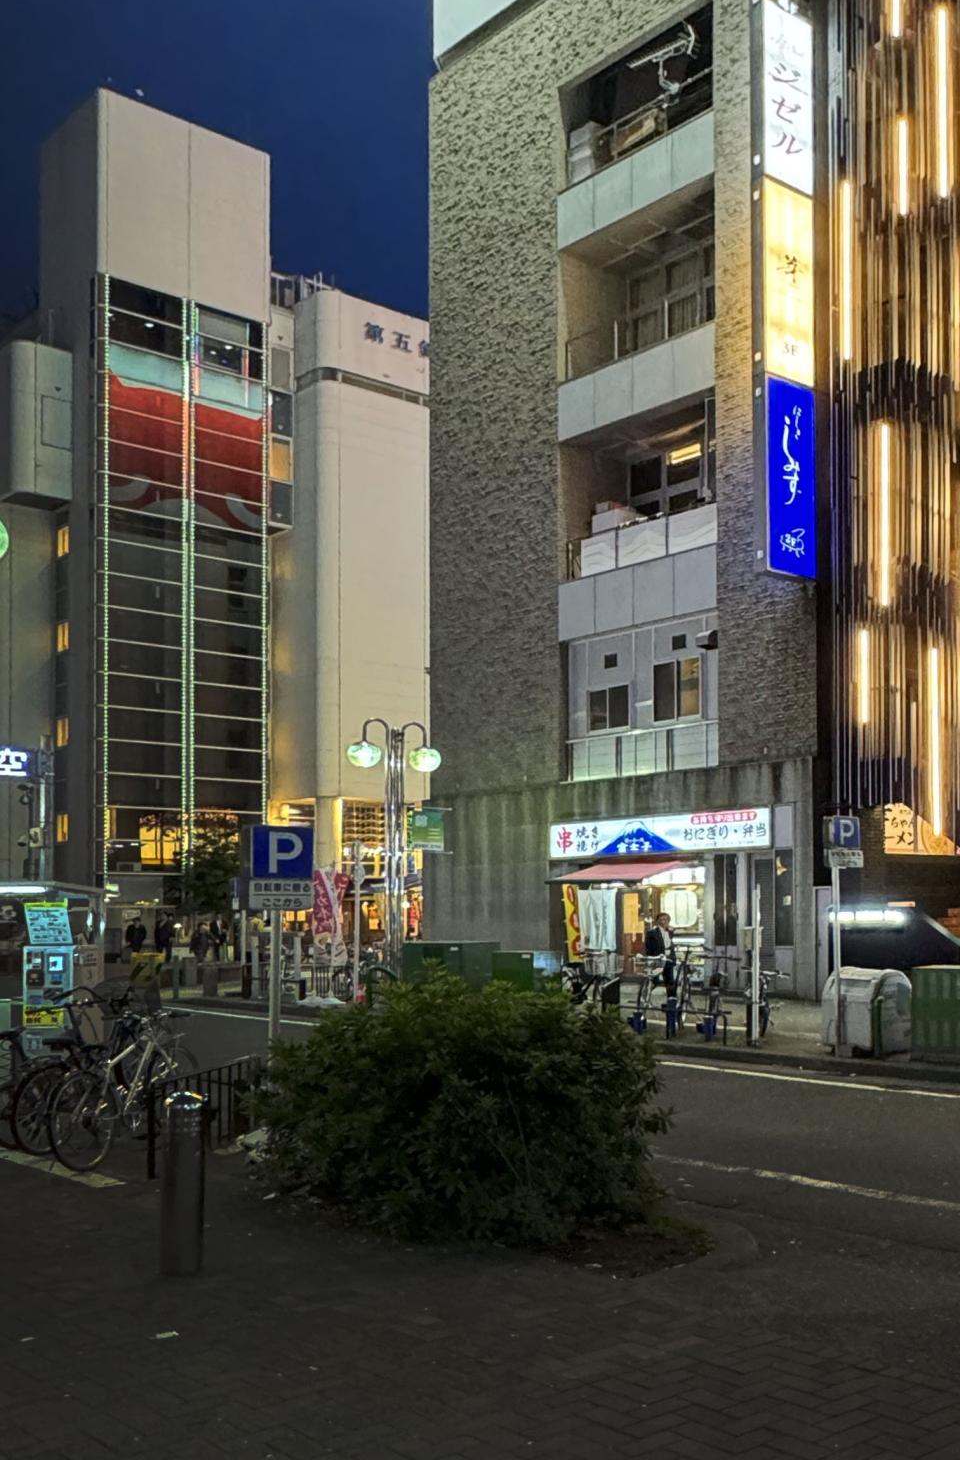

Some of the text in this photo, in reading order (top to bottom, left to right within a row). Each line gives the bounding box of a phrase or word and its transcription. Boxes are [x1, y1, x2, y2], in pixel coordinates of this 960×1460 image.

[556, 826, 573, 853] 串
[839, 818, 855, 845] P
[268, 831, 303, 873] P
[253, 882, 311, 893] 自転車に限る
[261, 897, 303, 908] ここから
